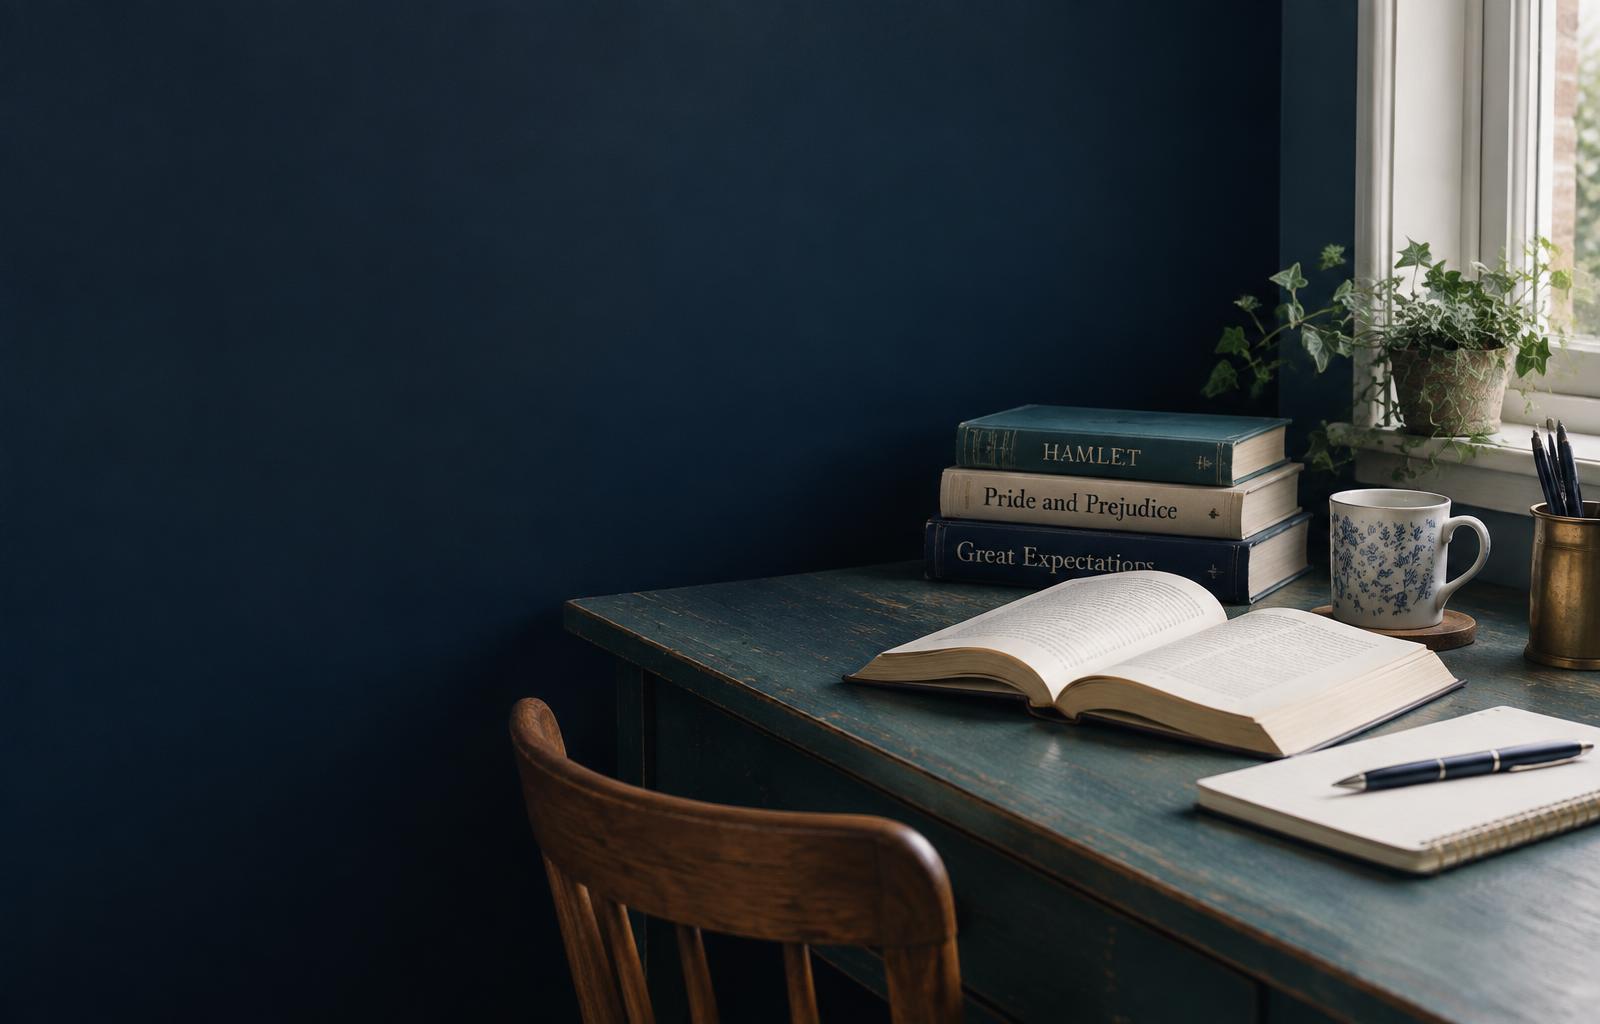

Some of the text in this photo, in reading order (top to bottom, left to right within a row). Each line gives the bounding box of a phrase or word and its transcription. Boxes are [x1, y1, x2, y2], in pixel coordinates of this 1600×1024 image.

[1043, 443, 1141, 466] HAMLET
[984, 487, 1177, 521] Pride and Prejudice
[957, 541, 1015, 565] Great
